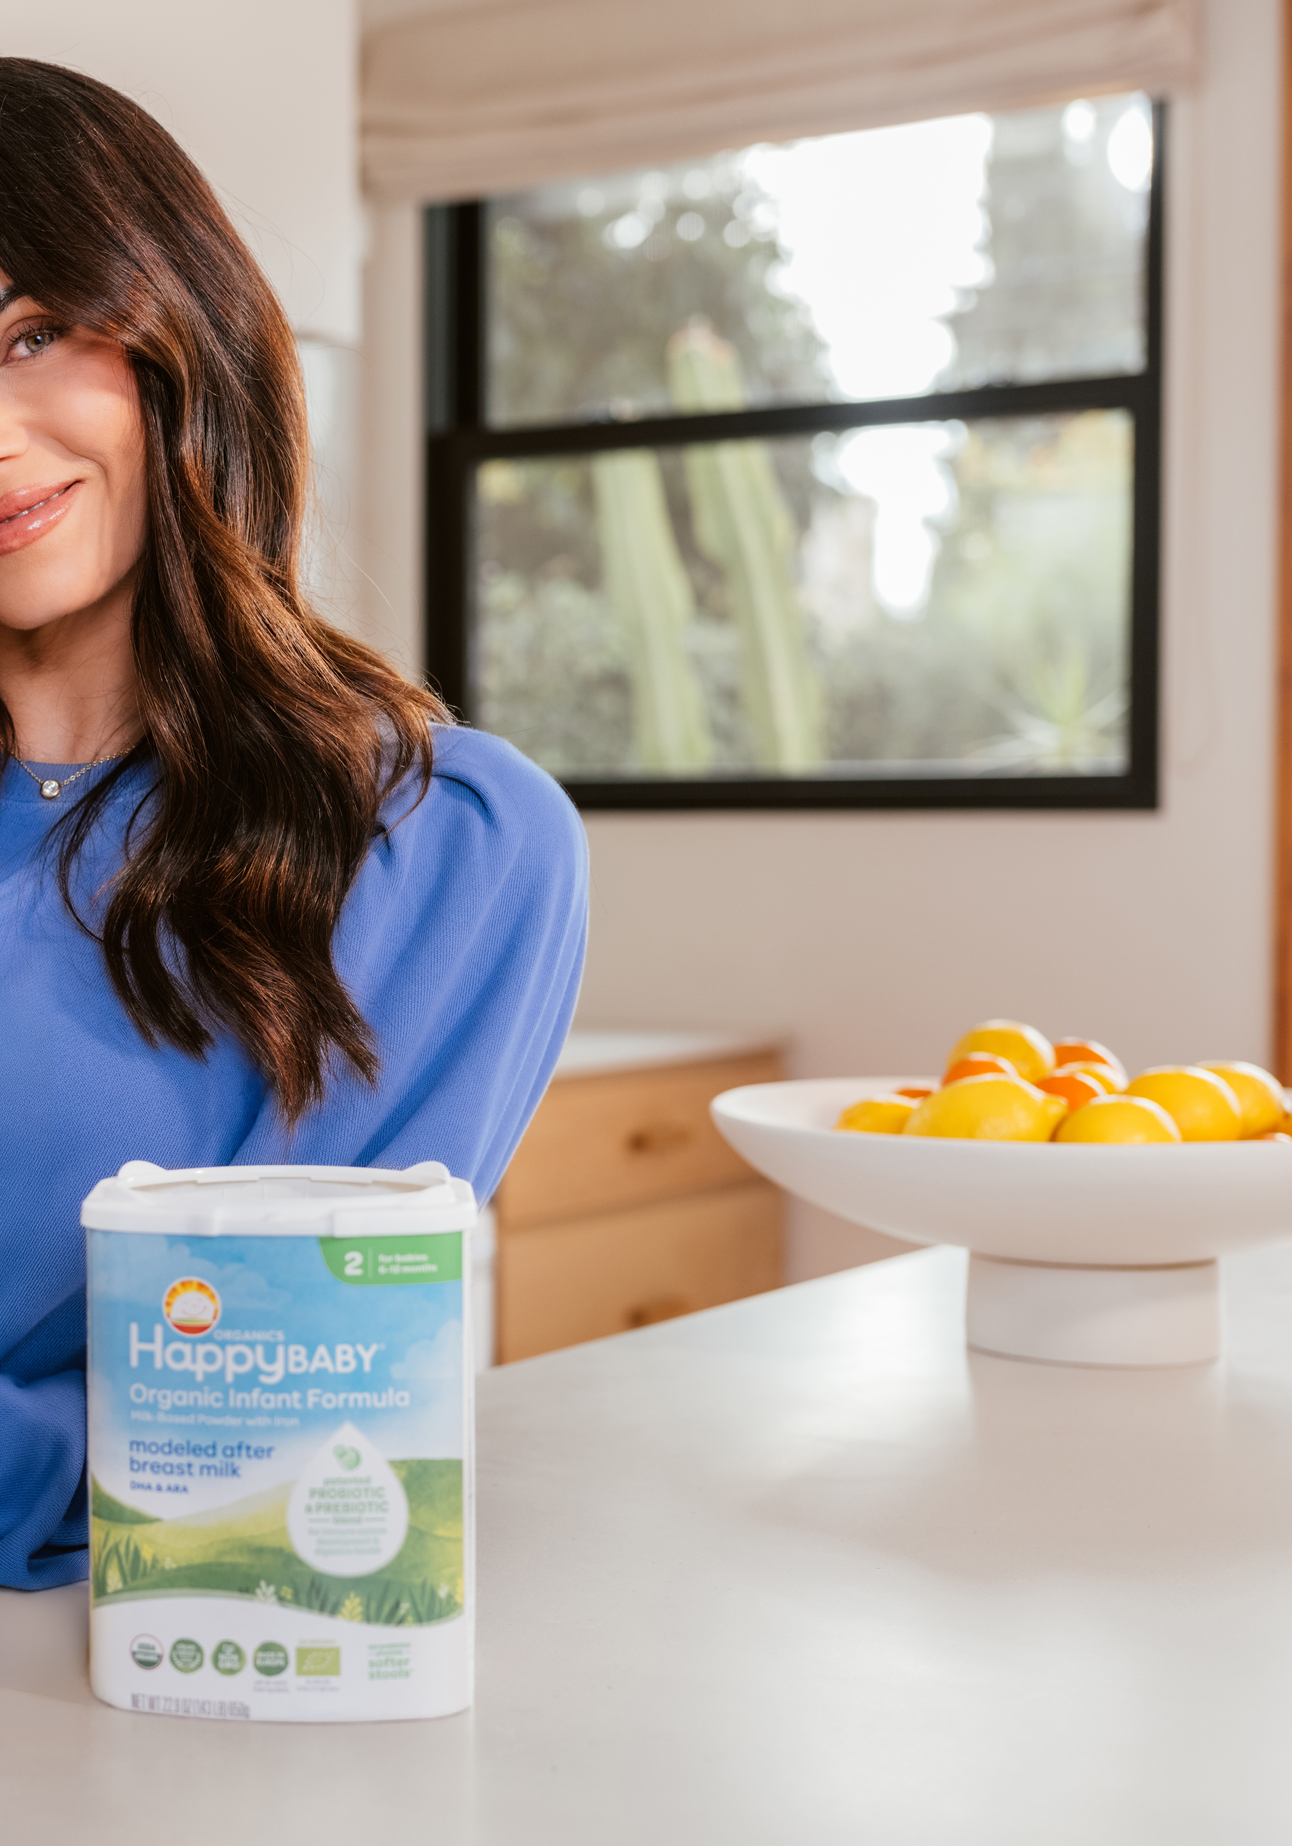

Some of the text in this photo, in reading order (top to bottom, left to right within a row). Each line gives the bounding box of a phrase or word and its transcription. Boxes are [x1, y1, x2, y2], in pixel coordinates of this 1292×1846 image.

[344, 1251, 364, 1276] 2
[377, 1252, 428, 1264] for babies
[402, 1263, 439, 1275] months
[213, 1329, 285, 1342] ORGANICS
[129, 1382, 410, 1411] Organic Infant Formula
[130, 1410, 300, 1427] Milk-Based Powder with Iron
[129, 1439, 275, 1460] modeled after
[129, 1456, 242, 1478] breast milk
[130, 1480, 189, 1493] DHA & ARA
[308, 1486, 385, 1499] PROBIOTIC
[315, 1500, 389, 1514] PREBIOTIC
